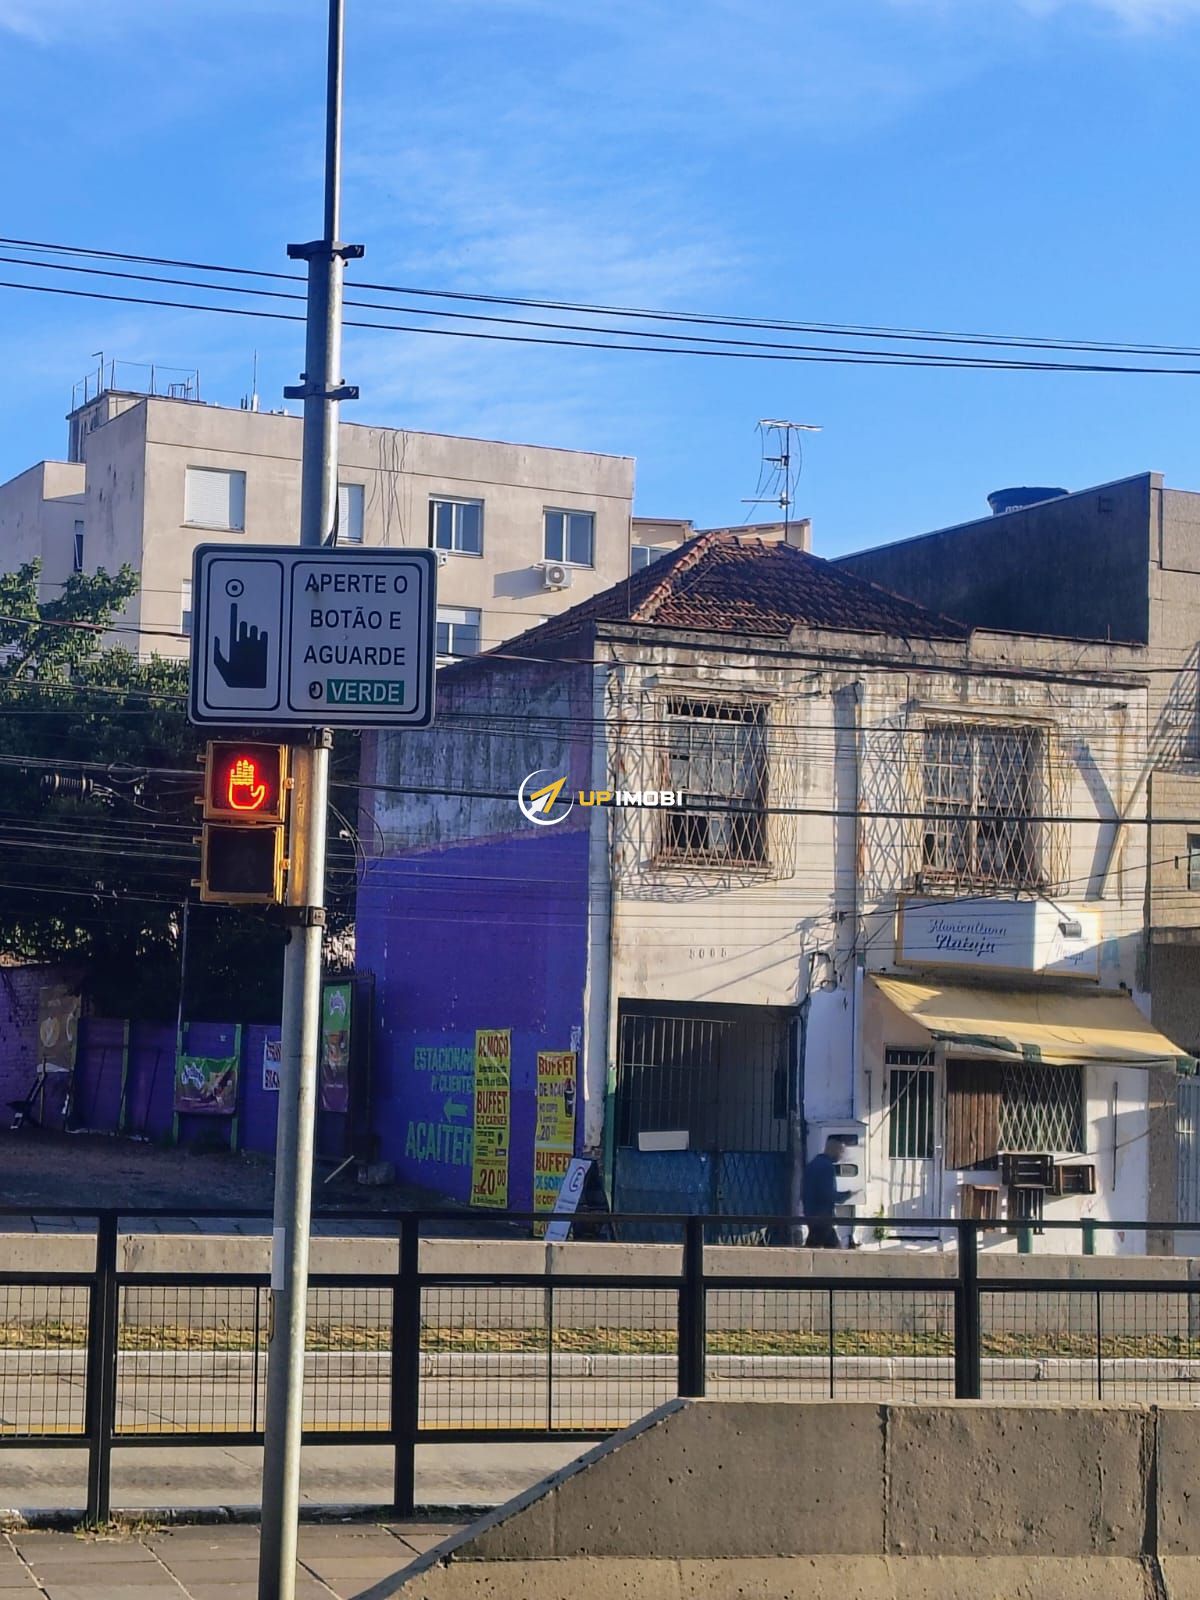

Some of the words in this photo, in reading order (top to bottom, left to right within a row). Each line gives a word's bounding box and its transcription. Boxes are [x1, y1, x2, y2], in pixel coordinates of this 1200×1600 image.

[304, 573, 387, 593] APERTE
[393, 575, 408, 594] O
[310, 606, 382, 629] BOTÃO
[389, 611, 401, 630] E
[303, 645, 406, 666] AGUARDE
[308, 680, 323, 700] O
[330, 682, 400, 702] VERDE
[414, 1047, 474, 1073] ESTACIONAM
[538, 1055, 575, 1076] BUFFET
[476, 1090, 508, 1115] BUFFET
[536, 1152, 572, 1172] BUFFE
